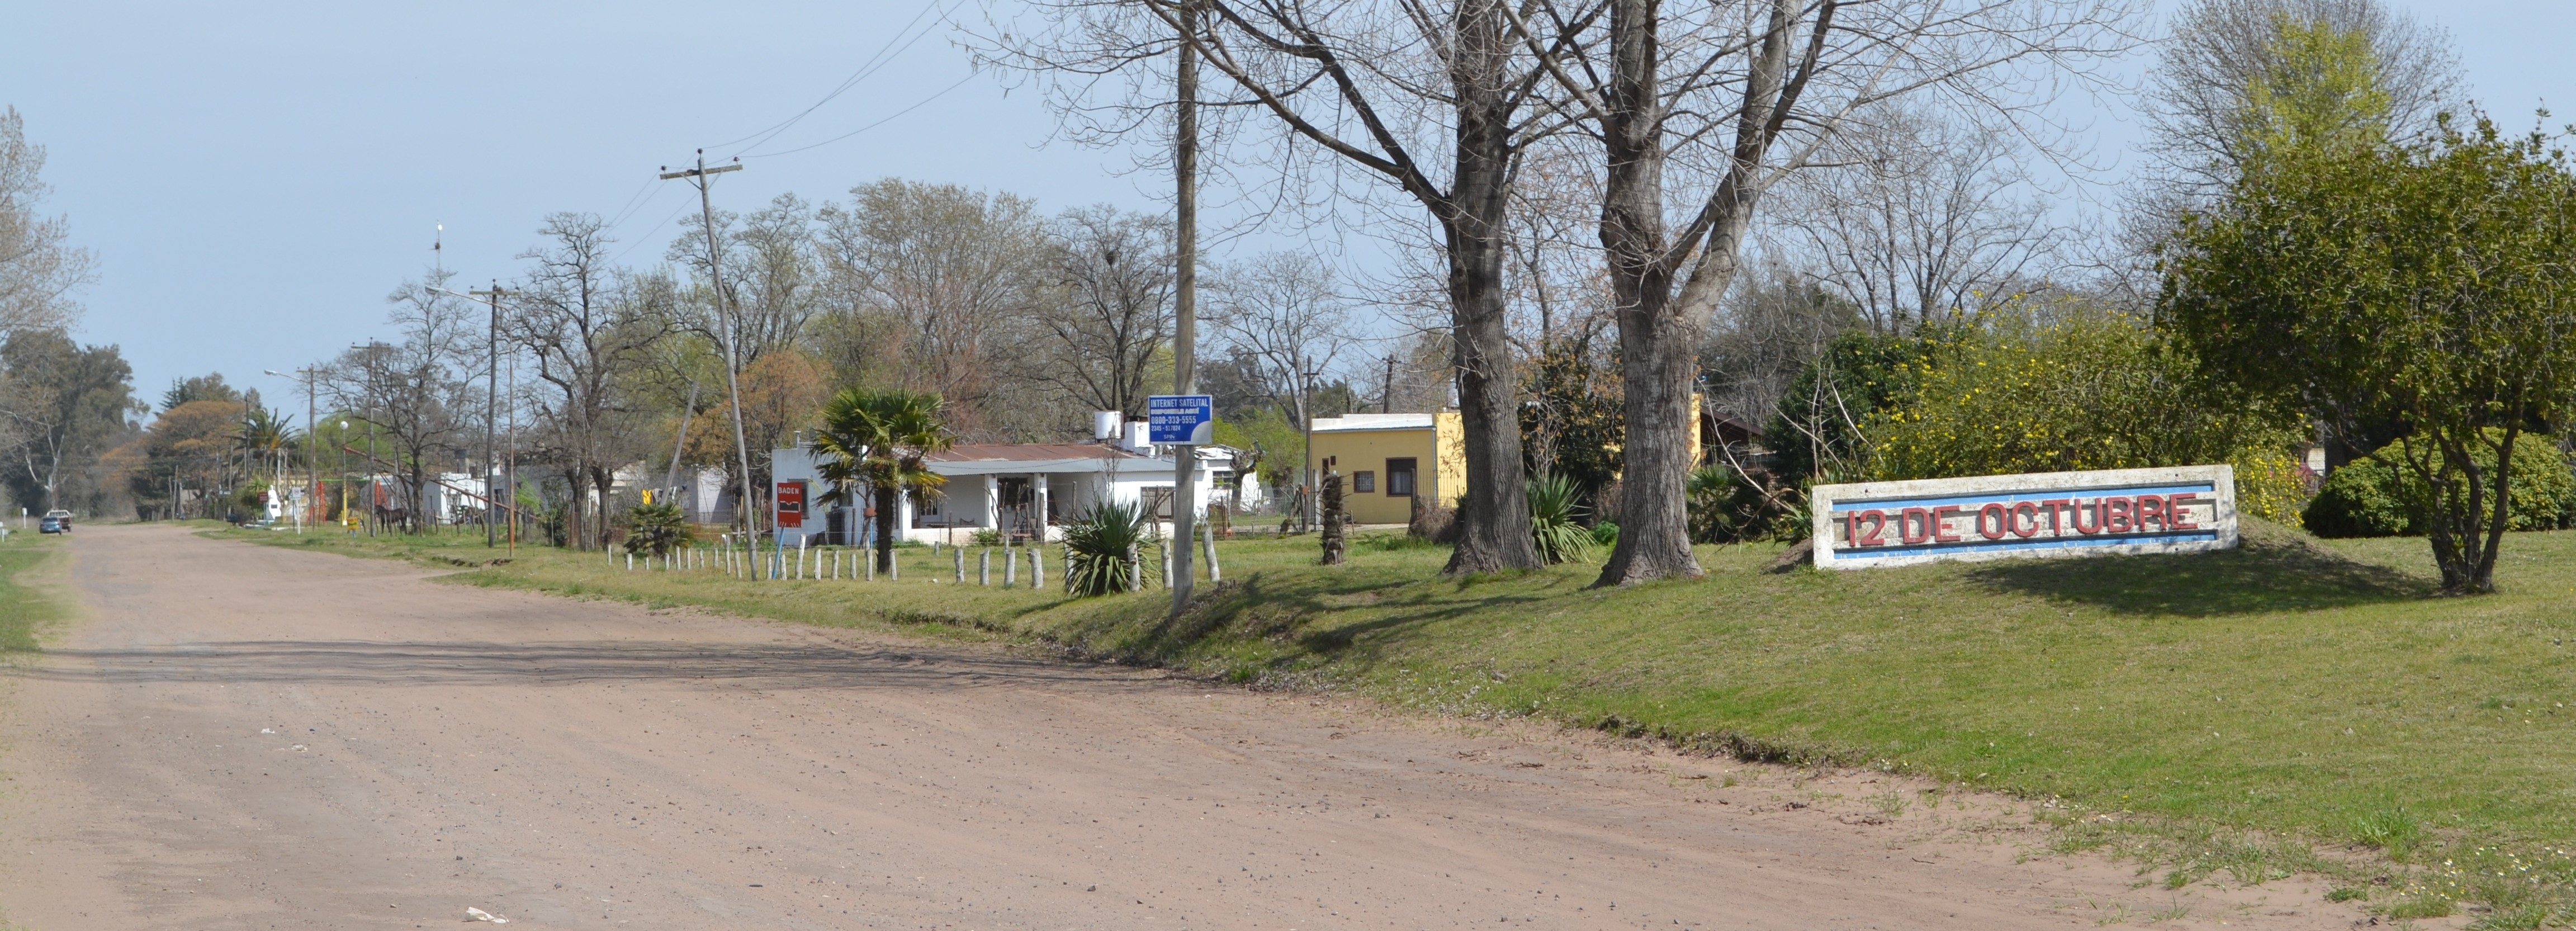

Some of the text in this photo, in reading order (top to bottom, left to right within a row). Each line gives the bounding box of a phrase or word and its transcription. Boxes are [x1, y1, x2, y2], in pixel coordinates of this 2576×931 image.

[1150, 398, 1208, 408] INTERNET SATELITAL
[1848, 492, 2199, 547] 12 DE OCTUBRE
